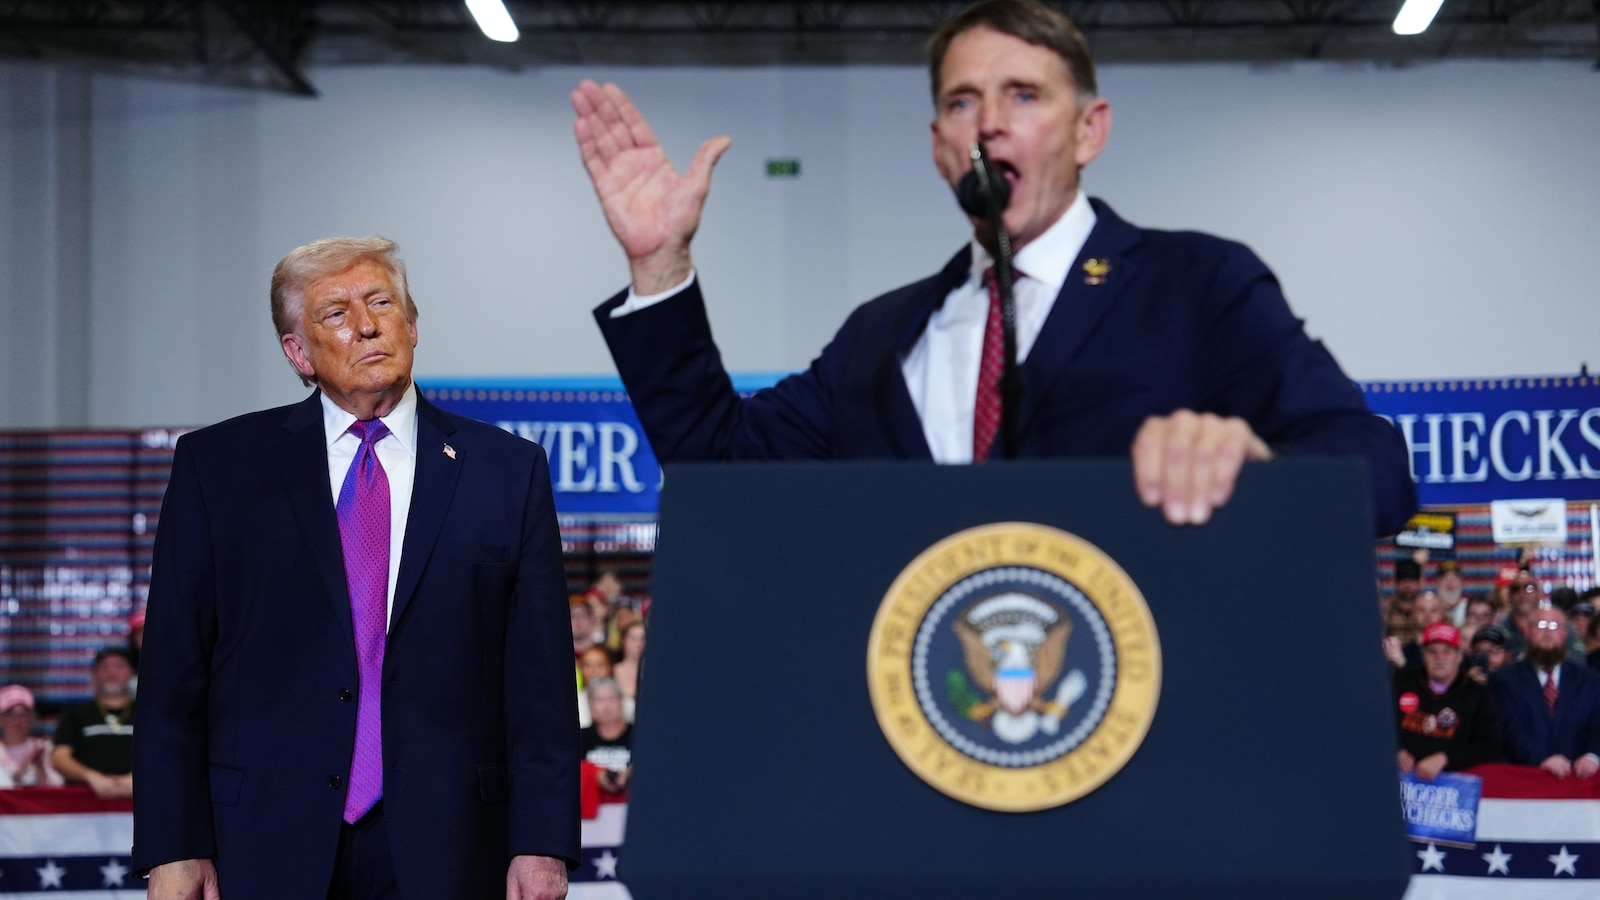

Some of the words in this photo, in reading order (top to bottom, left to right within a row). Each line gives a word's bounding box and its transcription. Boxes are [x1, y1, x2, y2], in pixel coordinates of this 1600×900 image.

[1374, 408, 1600, 483] HECKS
[1013, 539, 1038, 554] OF
[883, 537, 1004, 653] PRESIDENT
[1089, 566, 1149, 682] UNITED
[917, 741, 989, 792] SEAL
[1041, 710, 1136, 792] STATES
